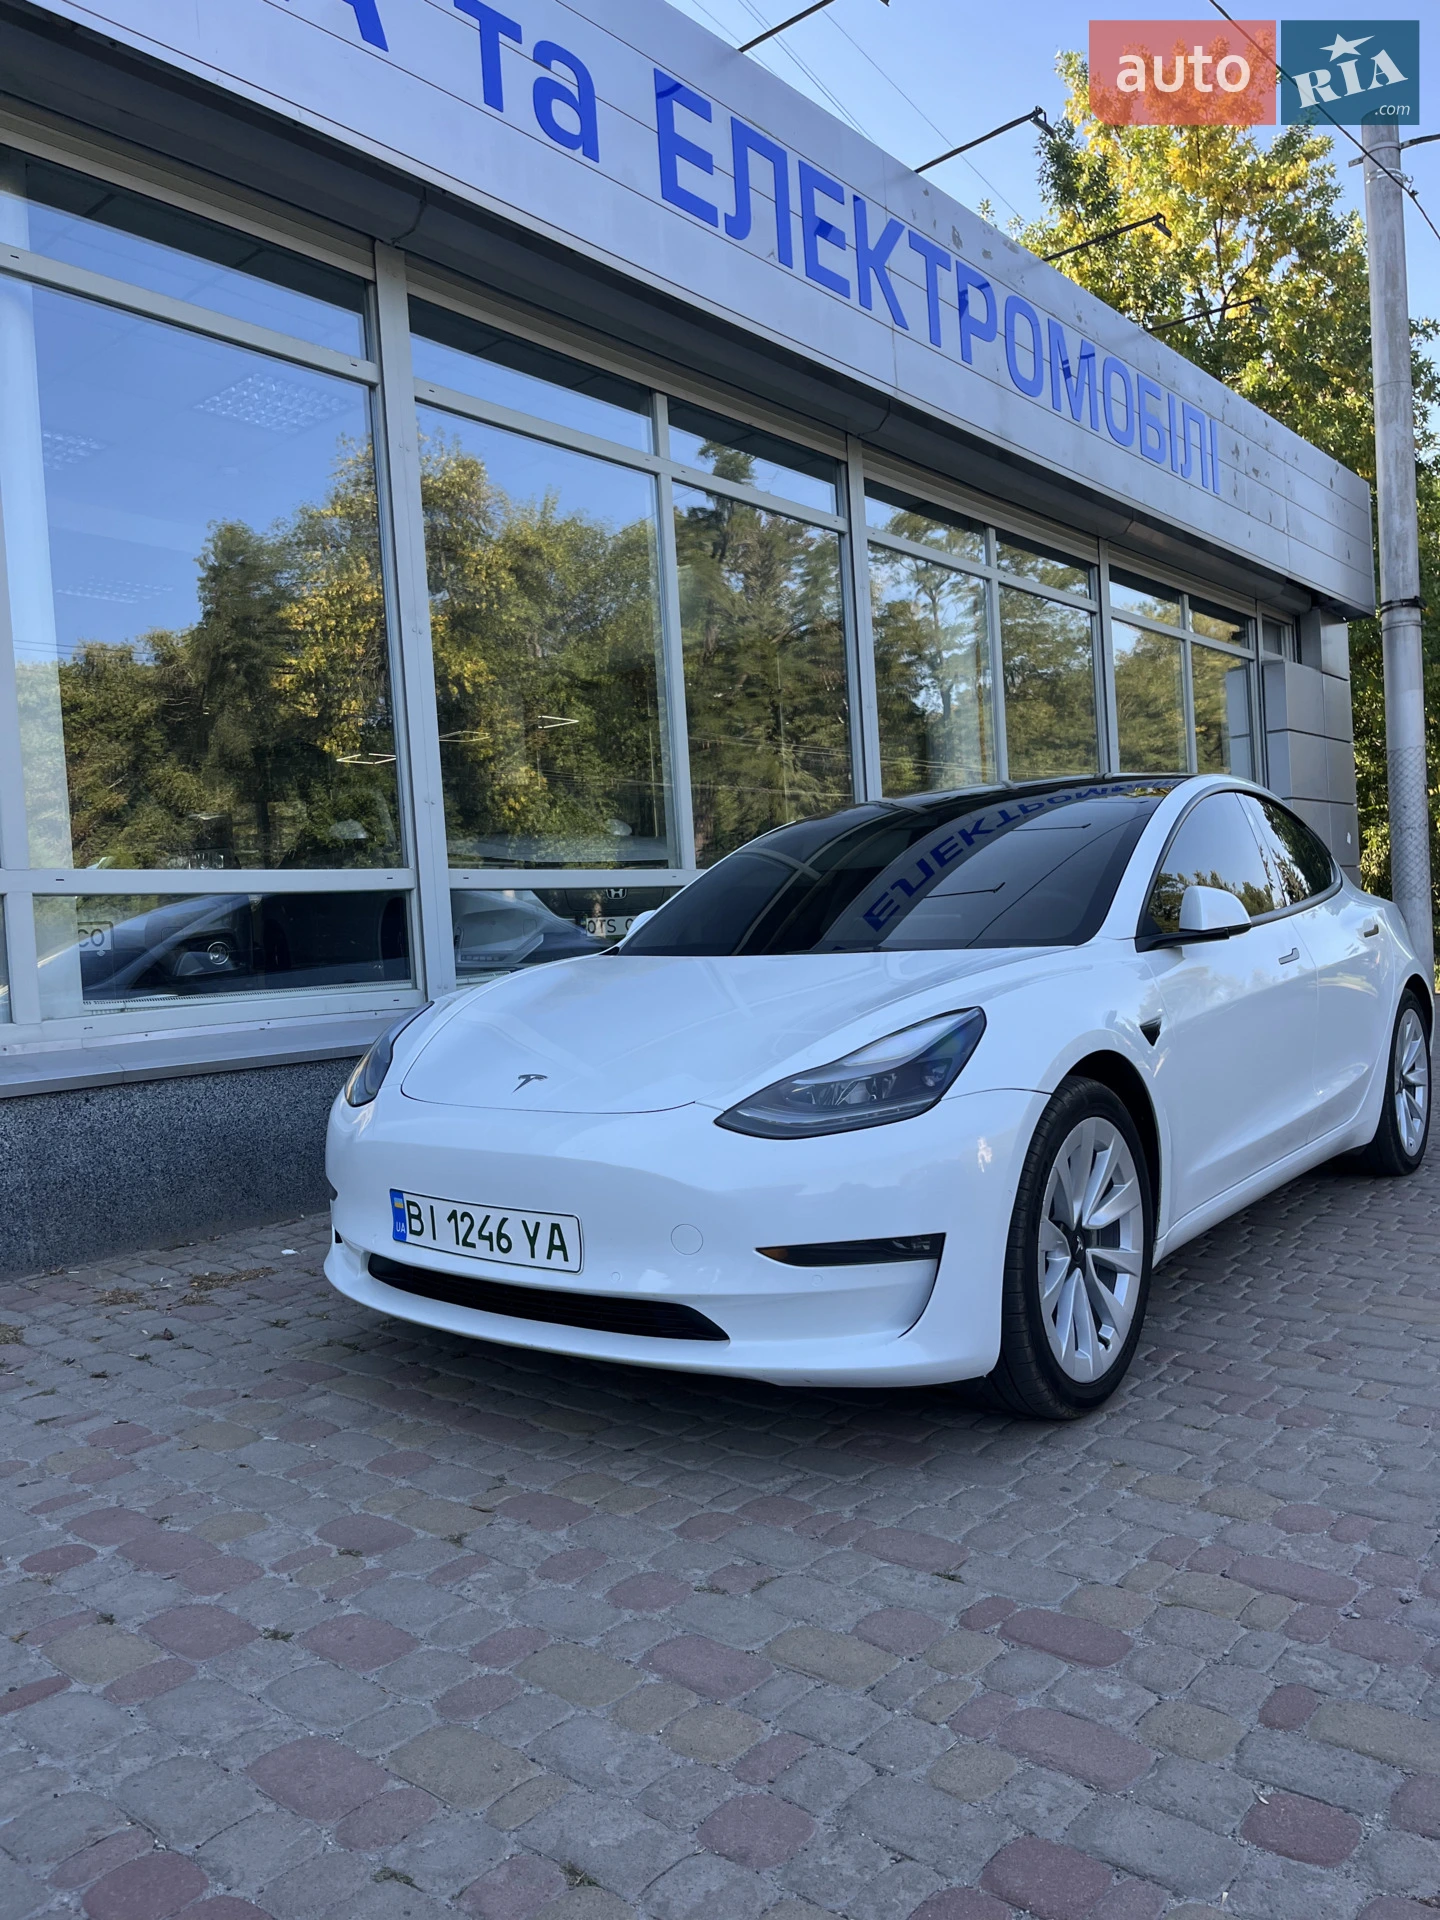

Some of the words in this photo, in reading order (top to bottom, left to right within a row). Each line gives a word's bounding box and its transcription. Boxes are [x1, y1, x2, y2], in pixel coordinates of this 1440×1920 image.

[453, 0, 600, 163] та
[652, 67, 1221, 496] ЕЛЕКТРОМОБІЛІ
[395, 1221, 406, 1234] UA
[406, 1200, 437, 1241] BI
[447, 1209, 513, 1254] 1246
[521, 1219, 569, 1263] YA
